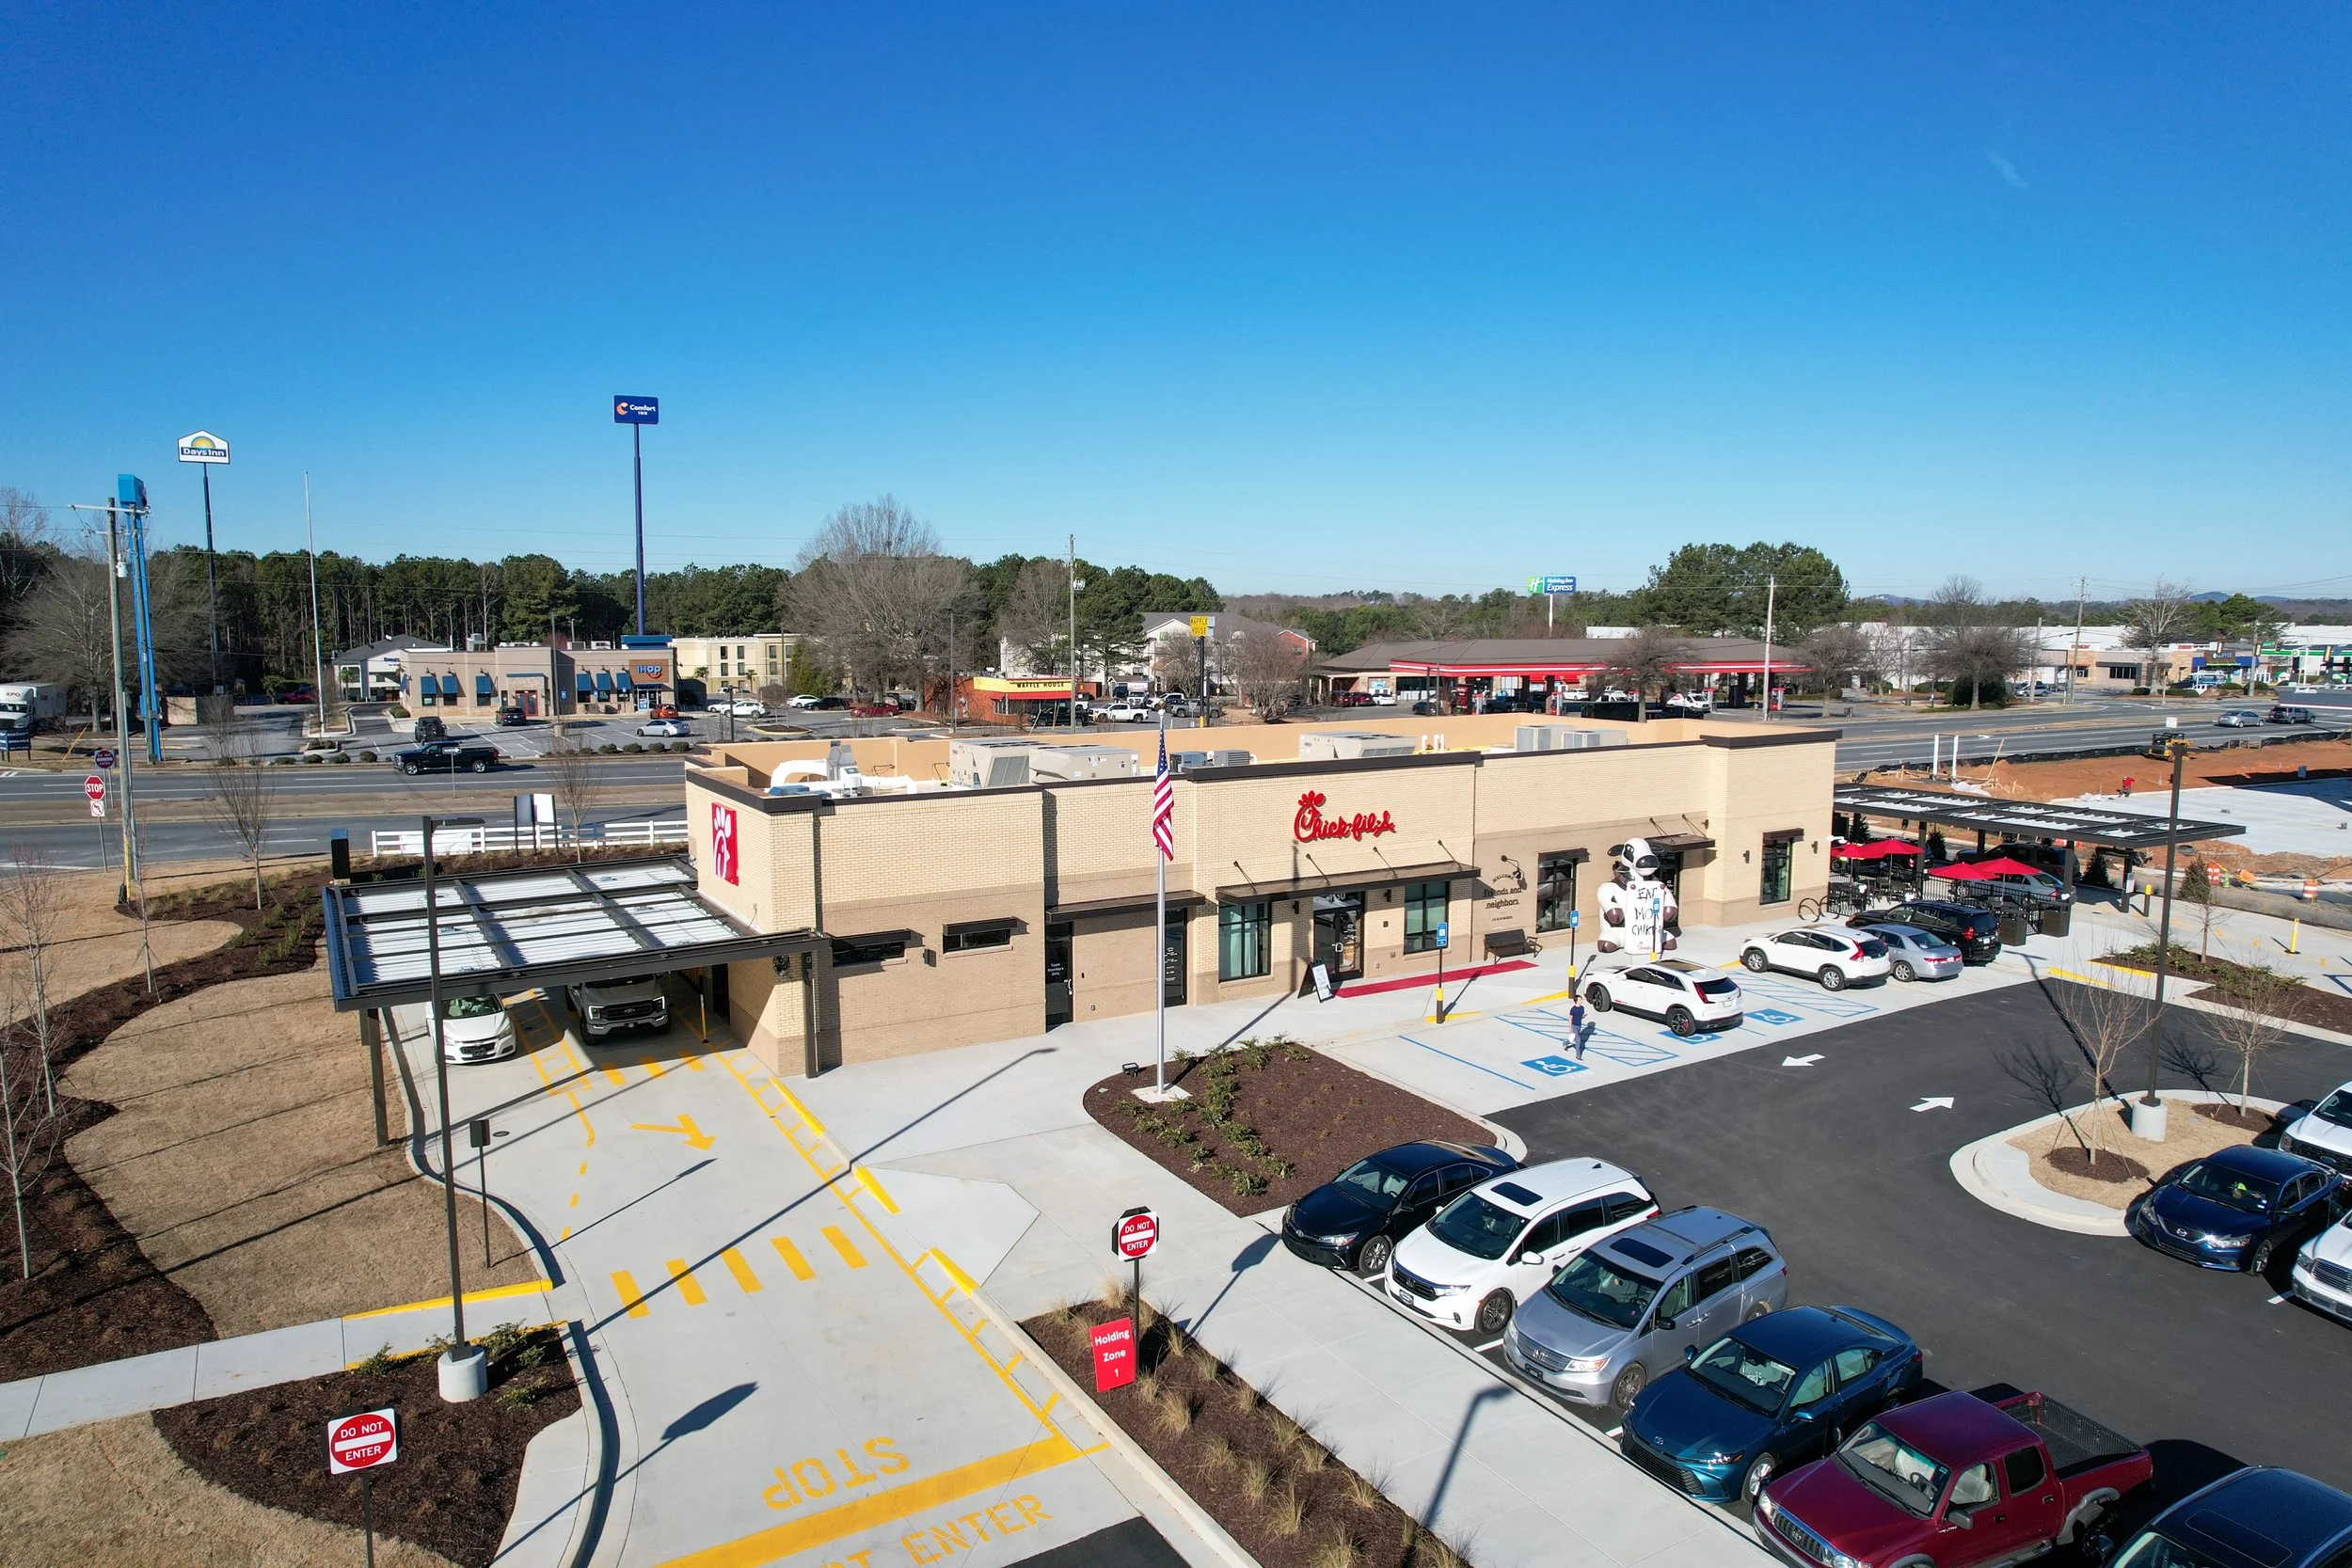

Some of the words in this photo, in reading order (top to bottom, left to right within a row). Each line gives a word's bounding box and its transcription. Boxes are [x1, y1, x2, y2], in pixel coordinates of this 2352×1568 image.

[183, 448, 207, 456] Days
[1190, 617, 1208, 626] WAFFLE
[1191, 626, 1206, 635] HOUSE
[87, 783, 103, 793] STOP
[1509, 886, 1523, 895] and
[1637, 887, 1658, 901] EAT
[1486, 898, 1521, 910] neighbors
[1124, 1225, 1135, 1234] DO
[1136, 1221, 1151, 1231] NOT
[1126, 1240, 1149, 1251] ENTER
[1094, 1329, 1130, 1346] Holding
[1103, 1349, 1126, 1362] Zone
[1114, 1368, 1120, 1377] 1
[341, 1427, 357, 1439] DO
[361, 1421, 383, 1434] NOT
[345, 1445, 382, 1462] ENTER
[761, 1436, 911, 1511] STOP
[899, 1495, 1055, 1566] ENTER
